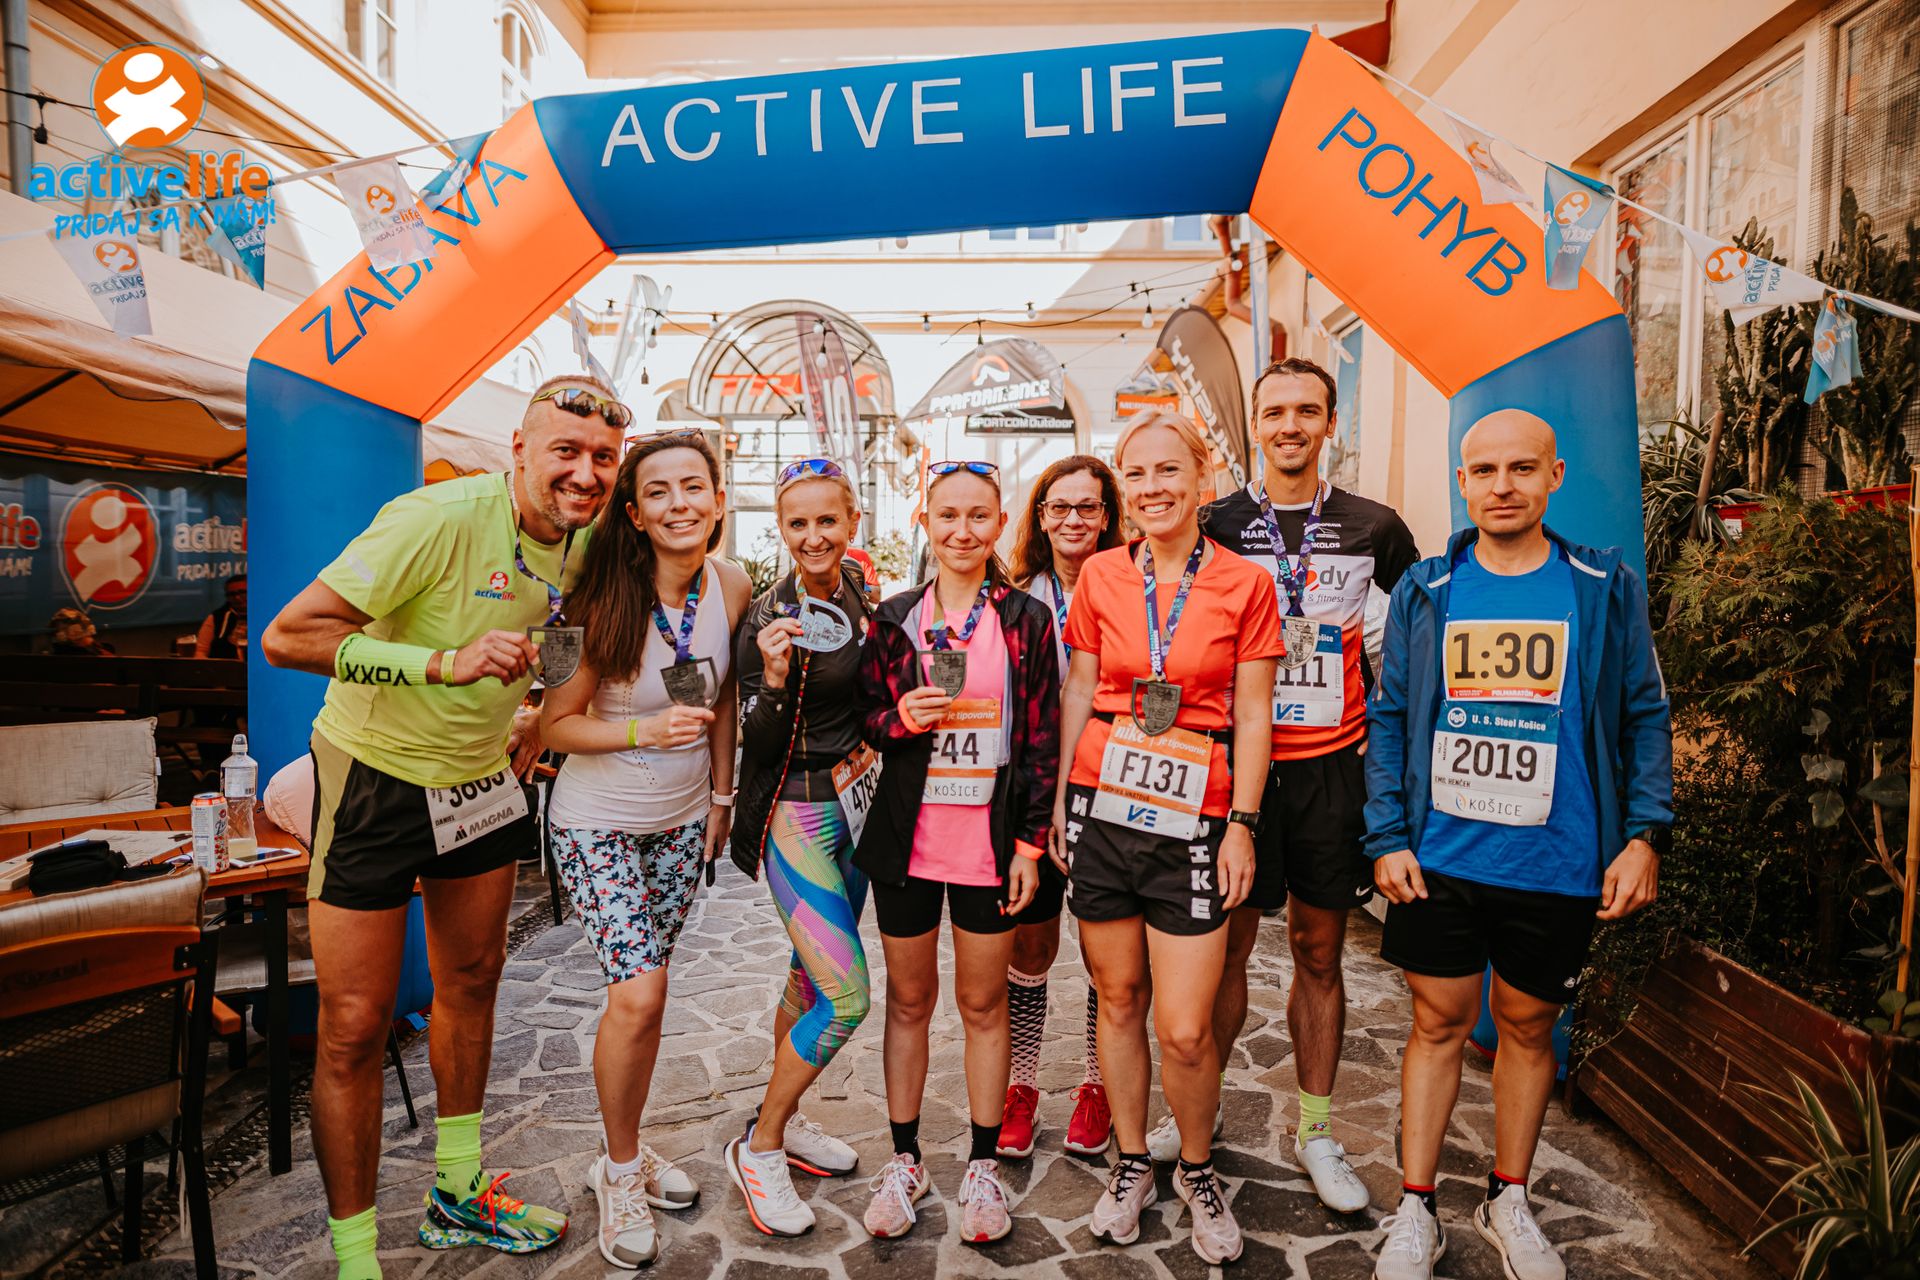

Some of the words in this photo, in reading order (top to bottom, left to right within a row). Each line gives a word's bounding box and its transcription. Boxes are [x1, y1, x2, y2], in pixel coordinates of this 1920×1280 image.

[601, 77, 964, 168] ACTIVE
[1022, 57, 1227, 139] LIFE
[1317, 107, 1527, 296] POHYB
[1317, 594, 1345, 603] fitness
[1453, 632, 1555, 681] 1:30
[1494, 716, 1516, 728] Steel
[1518, 719, 1547, 732] Košice
[1119, 750, 1189, 799] F131
[1452, 738, 1538, 783] 2019
[934, 783, 980, 798] KOŠICE
[1469, 798, 1523, 818] KOŠICE
[469, 806, 515, 835] MAGNA
